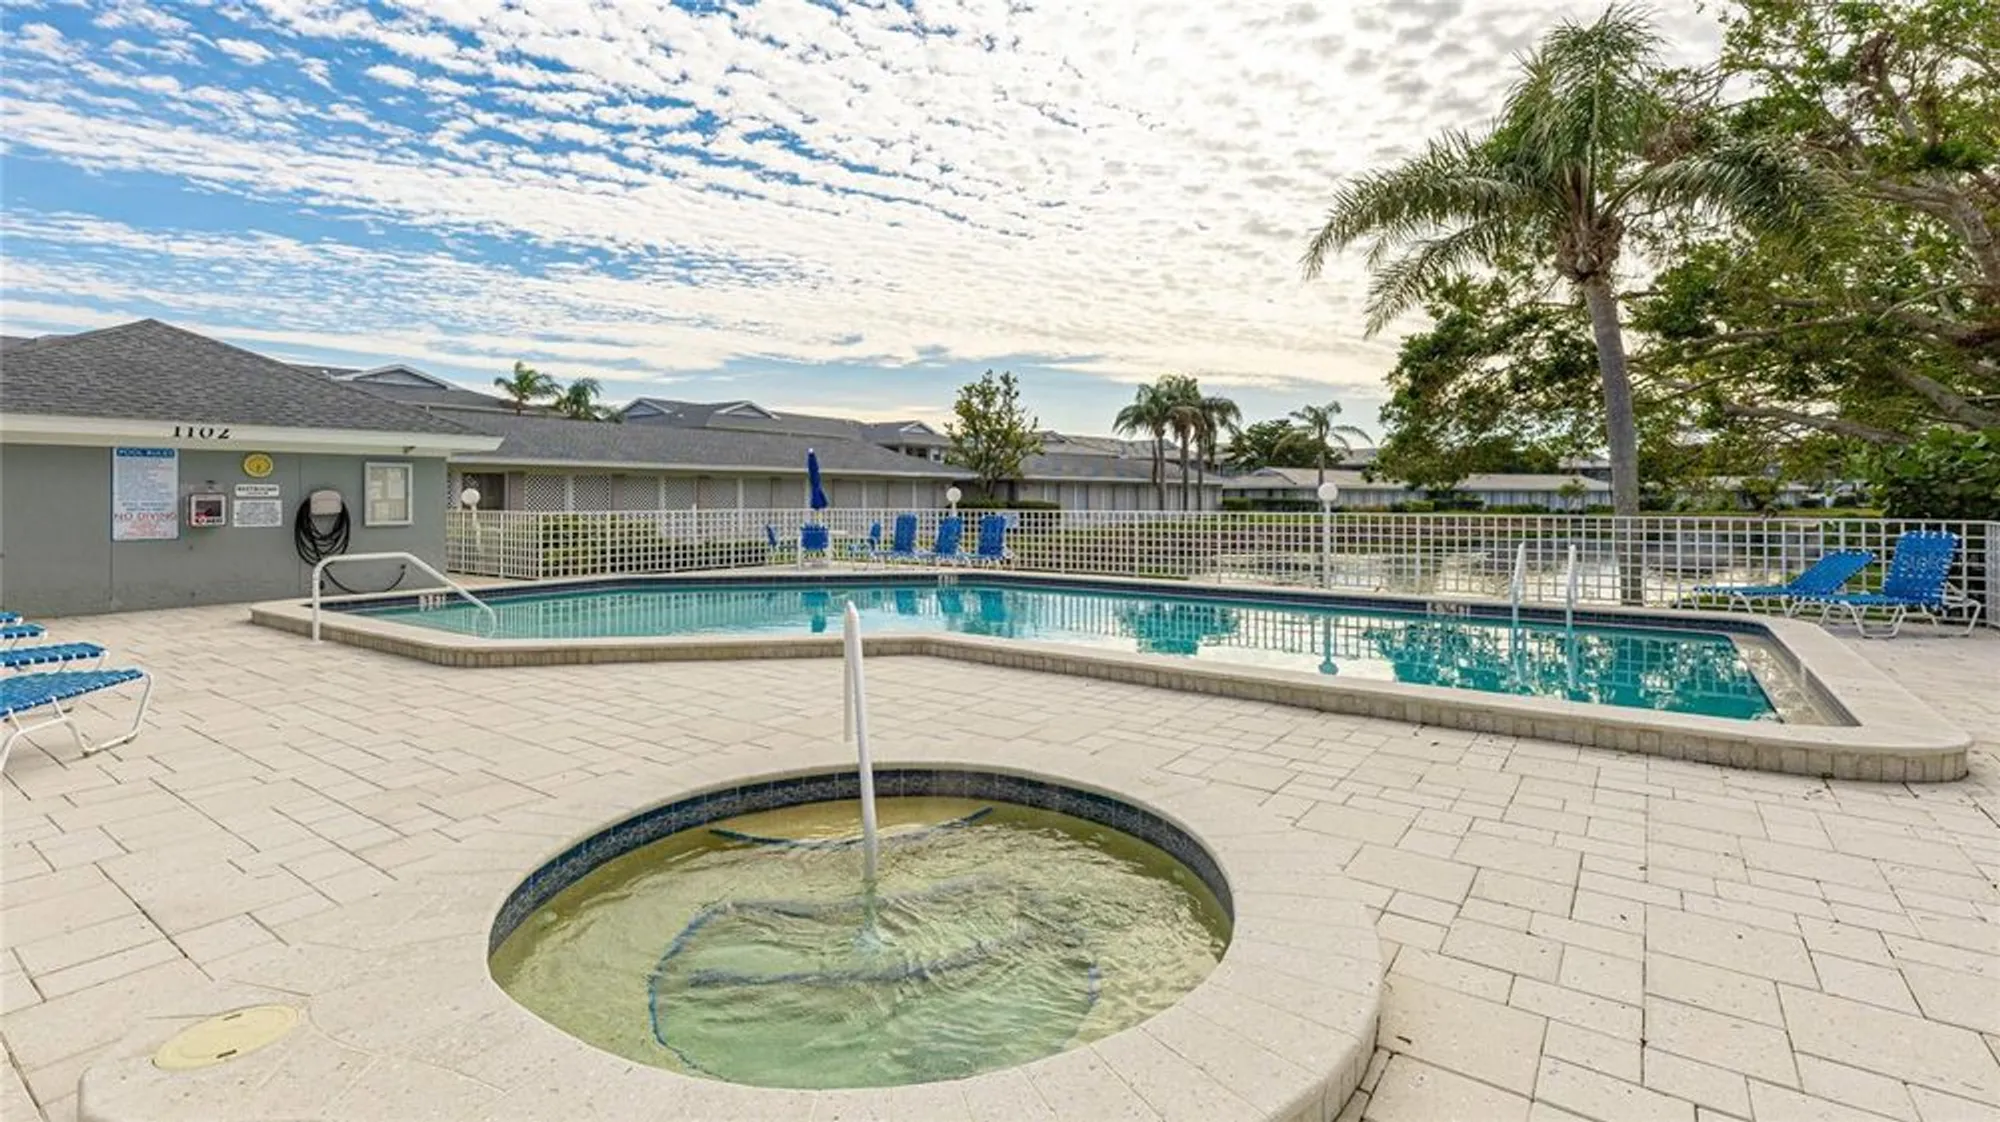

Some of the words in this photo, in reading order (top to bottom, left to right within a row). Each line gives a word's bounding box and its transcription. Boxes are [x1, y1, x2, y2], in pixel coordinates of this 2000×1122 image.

[173, 425, 231, 440] 1102
[114, 512, 134, 521] NO
[138, 512, 177, 521] DIVING
